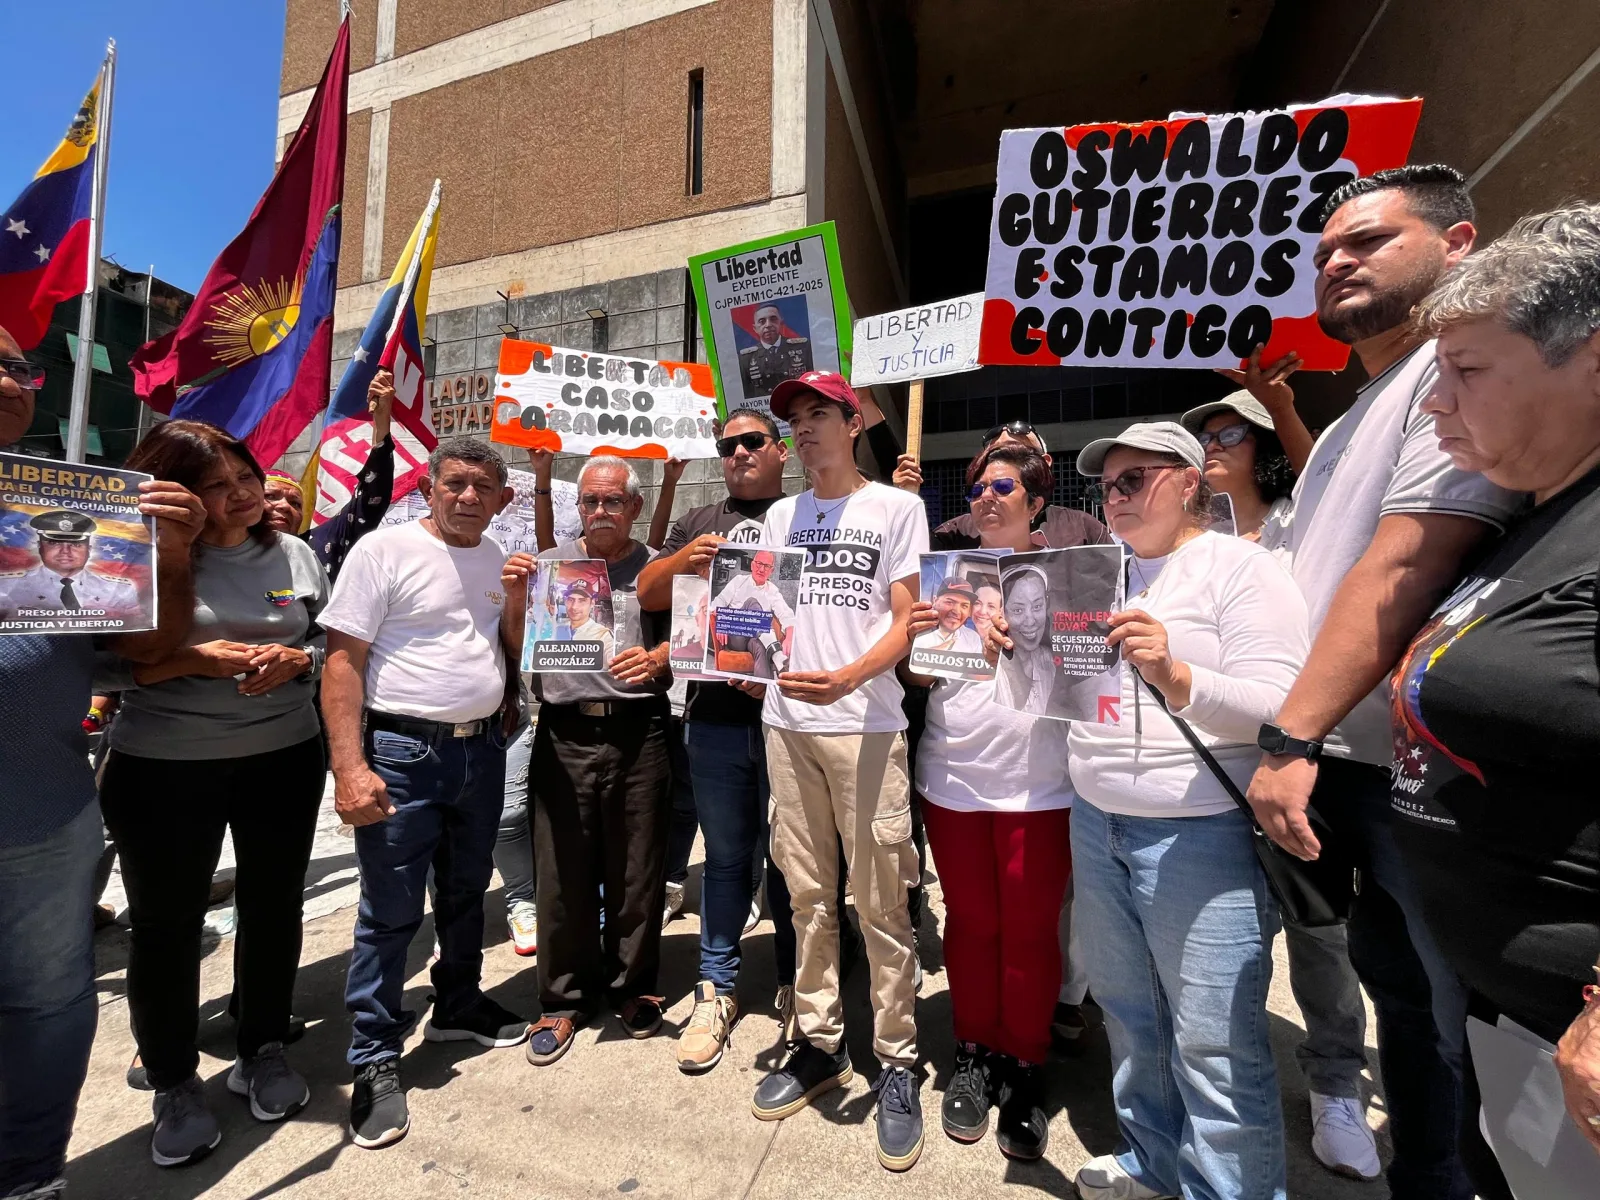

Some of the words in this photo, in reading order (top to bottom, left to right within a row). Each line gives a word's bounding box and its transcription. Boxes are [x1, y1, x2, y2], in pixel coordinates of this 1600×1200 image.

[1030, 108, 1349, 190] OSWALDO
[715, 242, 802, 283] Libertad
[1015, 239, 1301, 302] ESTAMOS
[732, 269, 799, 292] EXPEDIENTE
[715, 279, 823, 310] CJPM-TM1C-421-2025
[1010, 304, 1272, 360] CONTIGO
[532, 351, 692, 388] LIBERTAD
[428, 374, 488, 401] LACIO
[561, 383, 654, 412] CASO
[740, 400, 763, 408] MAYOR
[432, 403, 495, 428] ESTAD
[497, 402, 713, 439] PARAMACAY
[0, 462, 126, 492] LIBERTAD
[3, 493, 58, 507] CARLOS
[62, 500, 143, 515] CAGUARIPAN
[19, 484, 37, 494] EL
[41, 486, 102, 501] CAPITÁN
[106, 492, 141, 505] (GNB
[785, 529, 842, 547] LIBERTAD
[843, 528, 883, 548] PARA
[804, 549, 873, 571] ODOS
[808, 576, 873, 595] PRESOS
[800, 588, 870, 611] LÍTICOS
[0, 621, 55, 629] JUSTICIA
[69, 619, 124, 628] LIBERTAD
[18, 609, 55, 617] PRESO
[57, 609, 106, 617] POLÍTICO
[1053, 621, 1088, 632] TOVAR
[537, 644, 600, 653] ALEJANDRO
[1051, 635, 1105, 644] SECUESTRAD
[1052, 644, 1061, 652] EL
[1062, 644, 1113, 654] 17/11/2025
[539, 655, 595, 666] GONZÁLEZ
[913, 652, 964, 668] CARLOS
[966, 657, 994, 670] TOV
